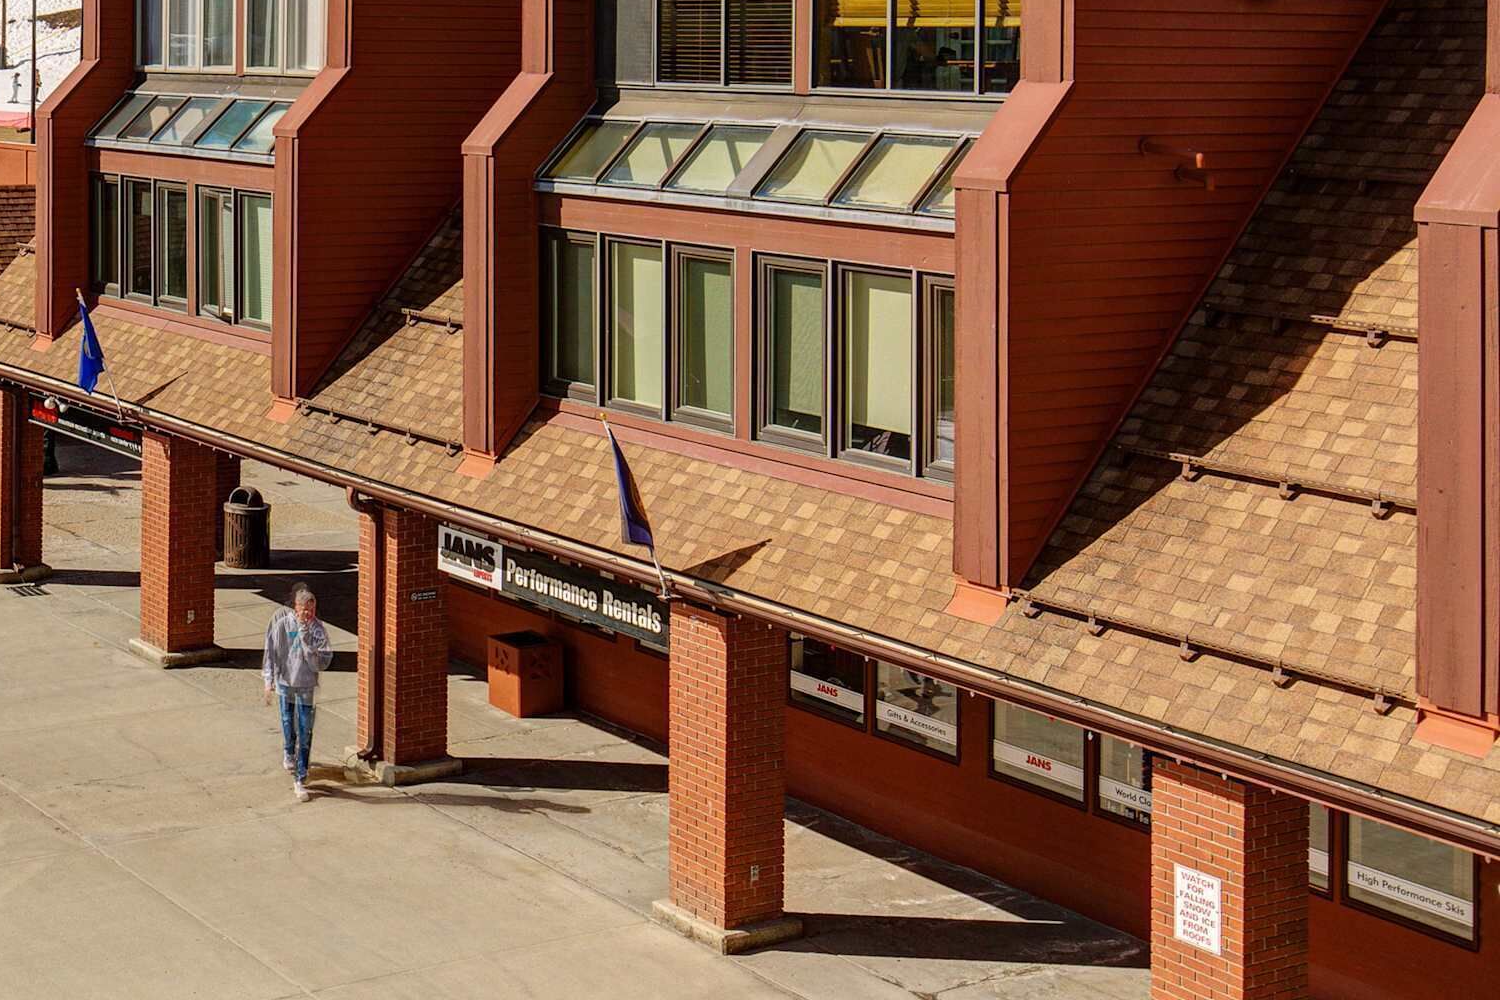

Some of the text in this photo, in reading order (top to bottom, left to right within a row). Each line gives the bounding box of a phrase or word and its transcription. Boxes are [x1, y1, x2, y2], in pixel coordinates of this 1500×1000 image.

[441, 532, 496, 573] JANS
[506, 558, 663, 634] Performance Rentals
[816, 683, 838, 698] JANS
[886, 708, 947, 736] Gifts & Accessories
[1025, 755, 1052, 772] JANS
[1115, 786, 1137, 802] World
[1181, 871, 1214, 889] WATCH
[1187, 883, 1204, 896] FOR
[1356, 871, 1465, 917] High Performance Skis
[1180, 890, 1215, 909] FALLING
[1183, 901, 1211, 917] SNOW
[1180, 909, 1216, 929] AND ICE
[1183, 919, 1208, 935] FROM
[1182, 928, 1212, 946] ROOFS
